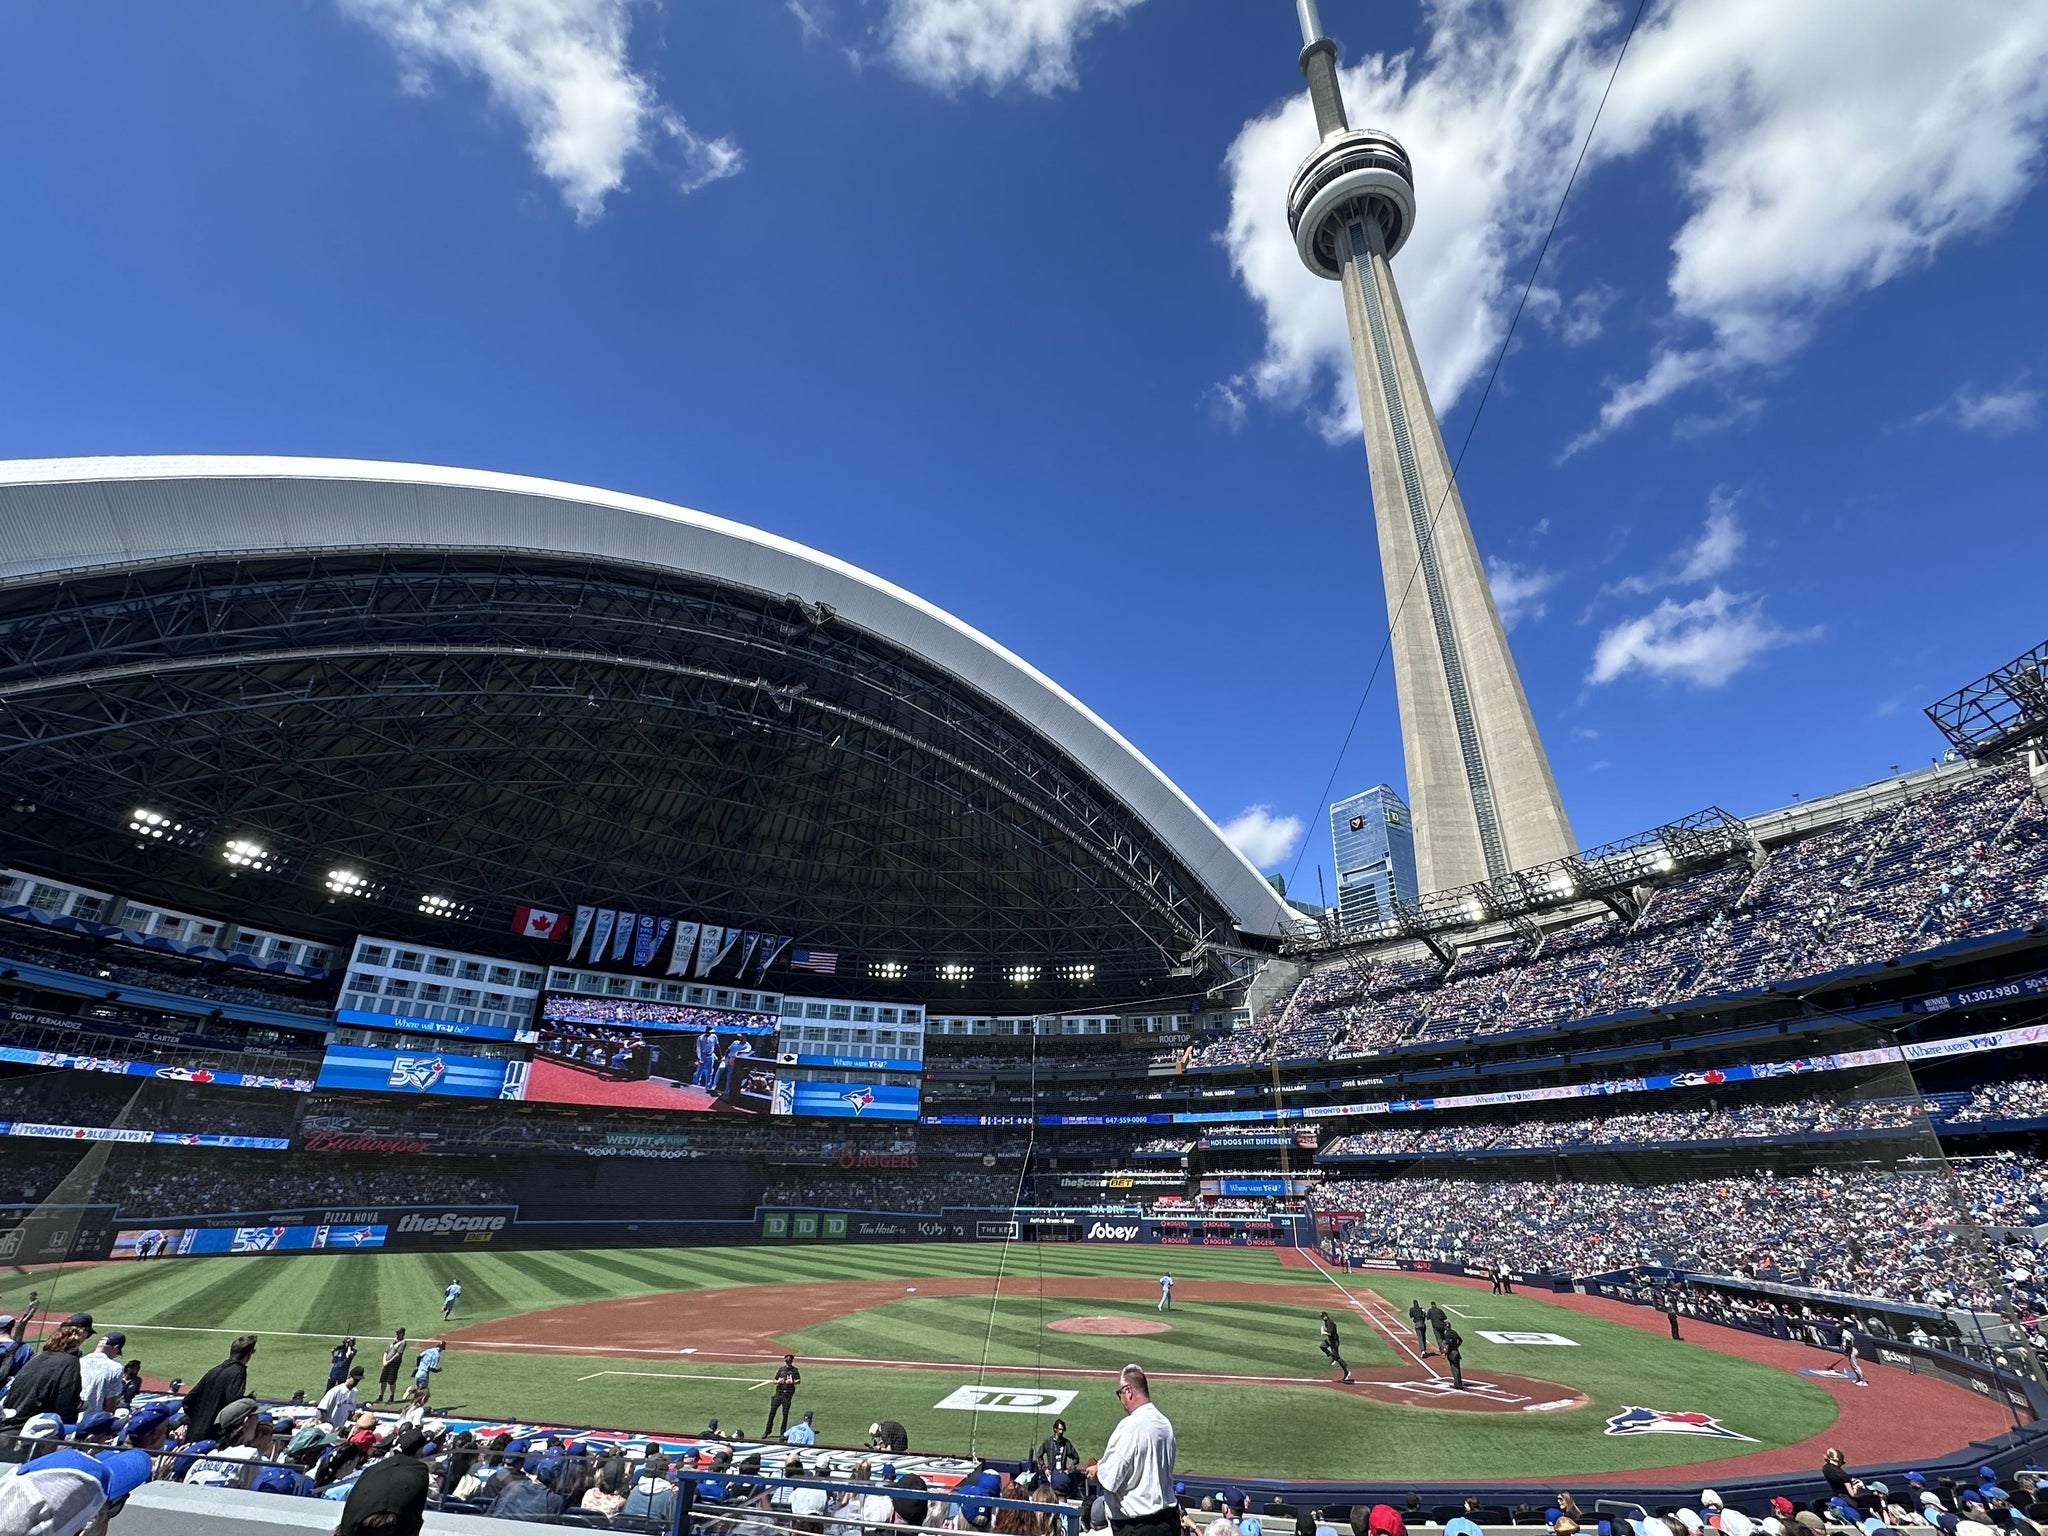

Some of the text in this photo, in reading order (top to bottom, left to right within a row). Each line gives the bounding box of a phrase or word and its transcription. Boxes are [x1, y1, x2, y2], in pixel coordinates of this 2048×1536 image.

[10, 1011, 82, 1030] TONY FERNANDEZ
[394, 1018, 420, 1029] Where
[421, 1022, 434, 1030] will
[454, 1025, 470, 1034] be?
[135, 1031, 180, 1044] JOE CARTER
[1159, 1034, 1191, 1043] ROOFTOP
[243, 1046, 271, 1055] GEORGE
[1906, 1044, 1942, 1058] Where
[1944, 1041, 1969, 1053] were
[833, 1057, 854, 1068] Where
[1475, 1094, 1495, 1104] Where
[1310, 1107, 1341, 1115] TORONTO
[1365, 1104, 1382, 1112] JAYS
[1105, 1116, 1148, 1124] 647-559-0060
[24, 1125, 140, 1140] TORONTO BLUE JAYS
[303, 1127, 431, 1152] Budweiser
[606, 1135, 653, 1147] WESTJET
[1223, 1138, 1242, 1146] DOGS
[1255, 1137, 1292, 1145] DIFFERENT
[858, 1155, 918, 1169] ROGERS
[1111, 1179, 1133, 1187] BET
[1229, 1181, 1248, 1192] Where
[323, 1211, 378, 1223] PIZZA NOVA
[397, 1213, 506, 1232] theScore
[858, 1222, 874, 1234] Tim
[918, 1222, 964, 1236] Kuba
[981, 1226, 996, 1234] THE
[1087, 1221, 1139, 1241] Sobeys
[467, 1233, 491, 1241] BET
[969, 1390, 1057, 1407] TD
